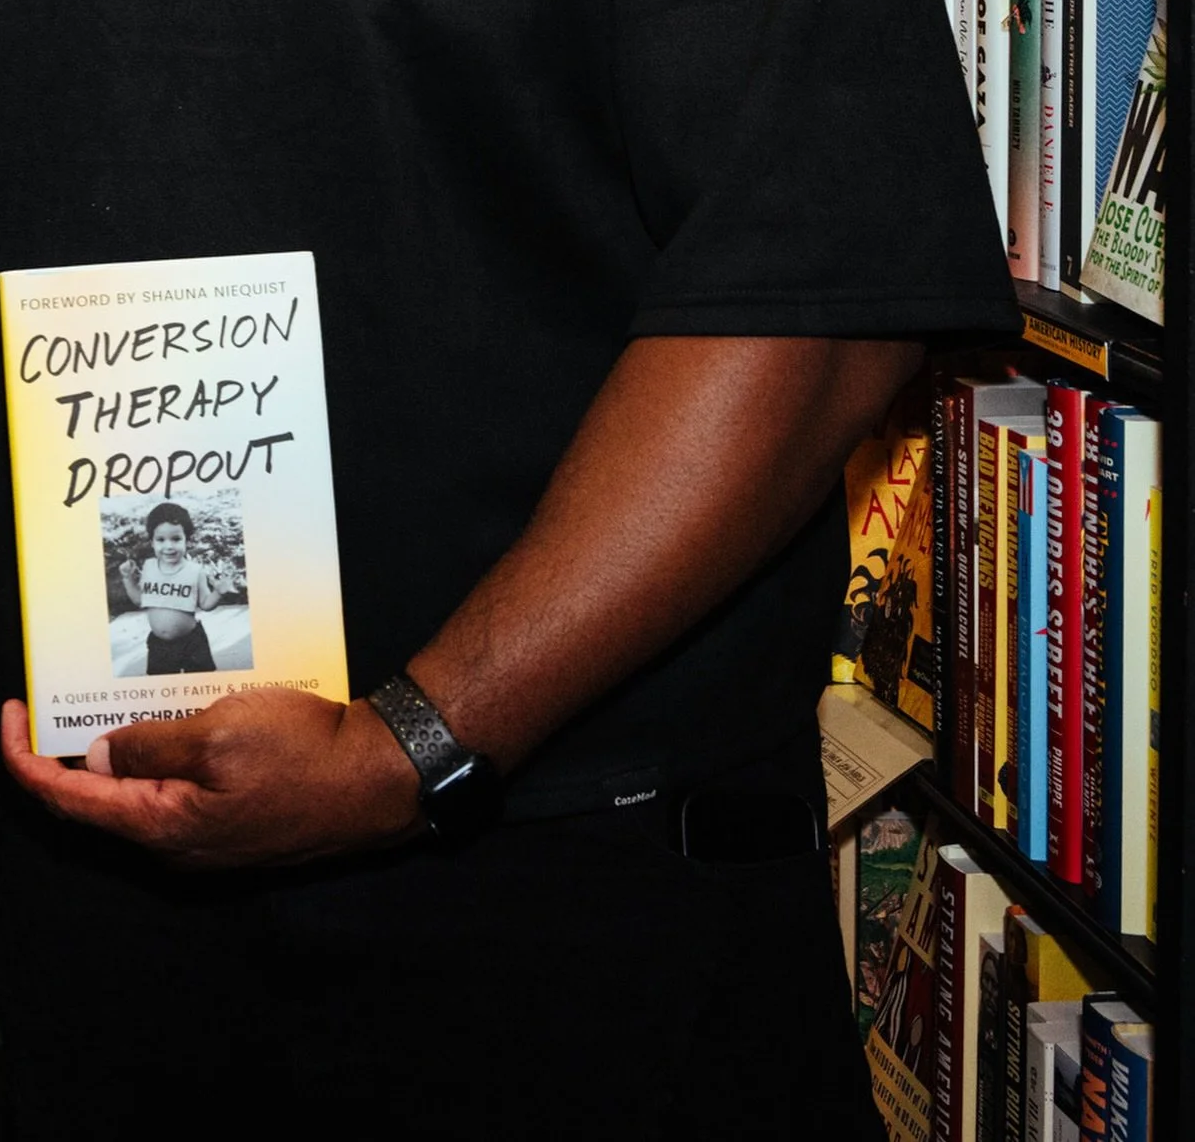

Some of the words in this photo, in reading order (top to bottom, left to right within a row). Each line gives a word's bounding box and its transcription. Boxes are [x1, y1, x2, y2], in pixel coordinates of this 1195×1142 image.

[977, 45, 987, 130] GAZA
[1045, 104, 1054, 185] DANIEL
[1090, 250, 1105, 266] FOR
[1105, 256, 1120, 276] THE
[1120, 260, 1148, 290] SPIRIT
[1147, 279, 1160, 293] OF
[1094, 227, 1109, 247] THE
[1111, 234, 1152, 267] BLOODY
[21, 294, 111, 311] FOREWORD
[117, 292, 136, 305] BY
[142, 287, 208, 304] SHAUNA
[214, 280, 287, 299] NIEQUIST
[19, 298, 299, 384] CONVERSION
[1029, 317, 1068, 344] AMERICAN
[1069, 334, 1102, 360] HISTORY
[56, 375, 279, 439] THERAPY
[1047, 409, 1062, 448] 38
[63, 431, 294, 507] DROPOUT
[979, 432, 994, 476] BAD
[958, 448, 967, 530] SHADOW
[936, 484, 944, 598] TRAVELED
[979, 478, 994, 591] MEXICANS
[1047, 458, 1062, 597] LONDRES
[142, 581, 193, 599] MACHO
[958, 552, 967, 659] QUETZALCOATL
[52, 694, 60, 704] A
[65, 691, 108, 705] QUEER
[113, 688, 155, 701] STORY
[161, 687, 177, 698] OF
[183, 684, 222, 697] FAITH
[227, 683, 236, 694] &
[1047, 607, 1062, 720] STREET
[53, 712, 124, 729] TIMOTHY
[1052, 746, 1062, 809] PHILIPPE
